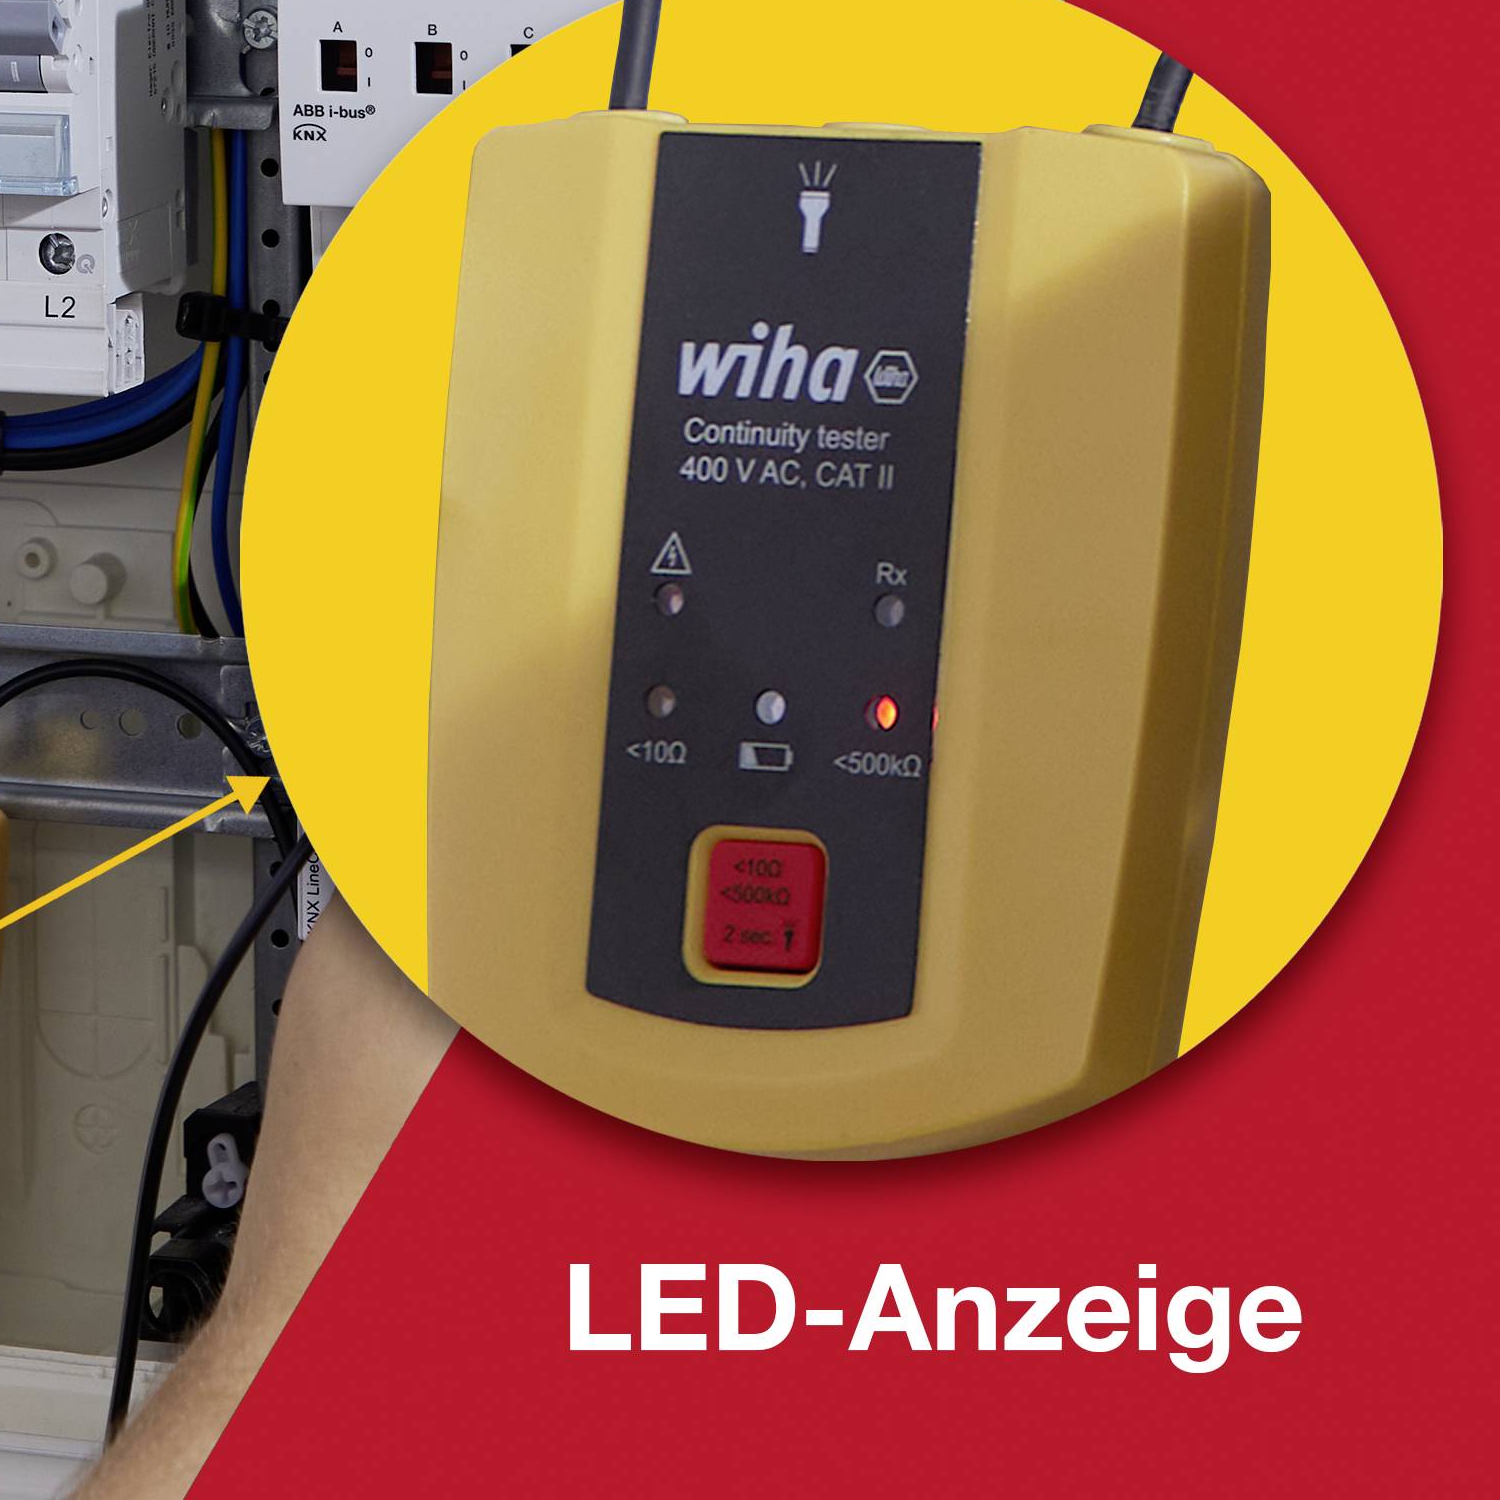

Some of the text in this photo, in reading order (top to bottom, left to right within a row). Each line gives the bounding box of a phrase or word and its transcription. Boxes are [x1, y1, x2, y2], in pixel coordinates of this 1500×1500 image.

[332, 21, 343, 33] A
[428, 24, 438, 36] B
[523, 27, 534, 39] C
[293, 104, 325, 117] ABB
[293, 130, 327, 142] KNX
[44, 296, 76, 319] L2
[678, 321, 859, 402] wiha
[684, 417, 890, 453] Continuity tester
[679, 456, 894, 489] 400 V AC, CAT II
[876, 562, 907, 585] Rx
[626, 741, 687, 764] <10Ω
[833, 753, 922, 778] <500kΩ
[724, 925, 734, 942] 2
